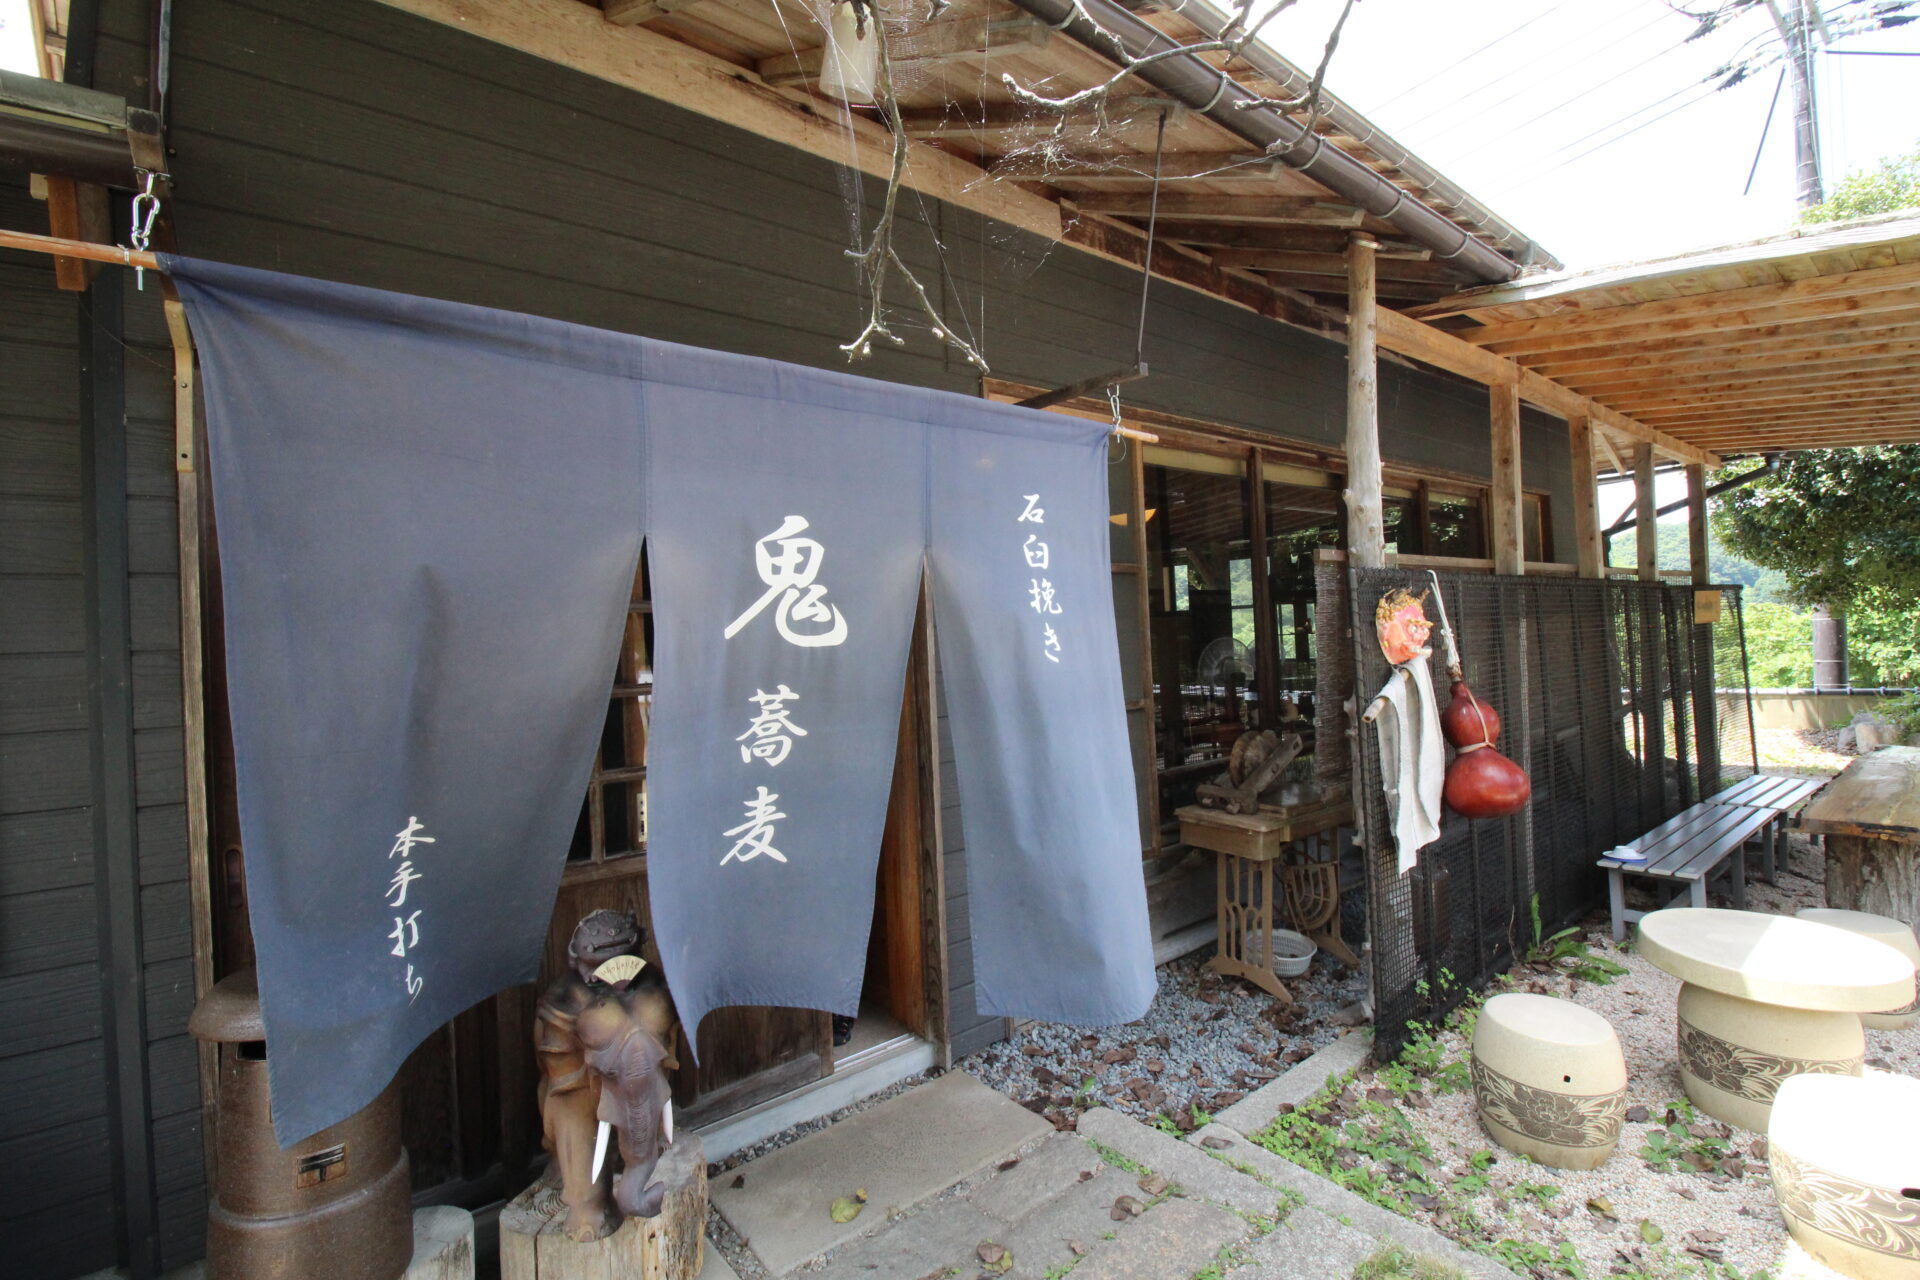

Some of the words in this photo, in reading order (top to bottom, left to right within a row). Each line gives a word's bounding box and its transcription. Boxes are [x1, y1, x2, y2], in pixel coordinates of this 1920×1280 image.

[1018, 494, 1063, 663] 石臼挽き
[720, 515, 848, 867] 鬼蕎麦
[385, 816, 436, 1006] 本手打ち
